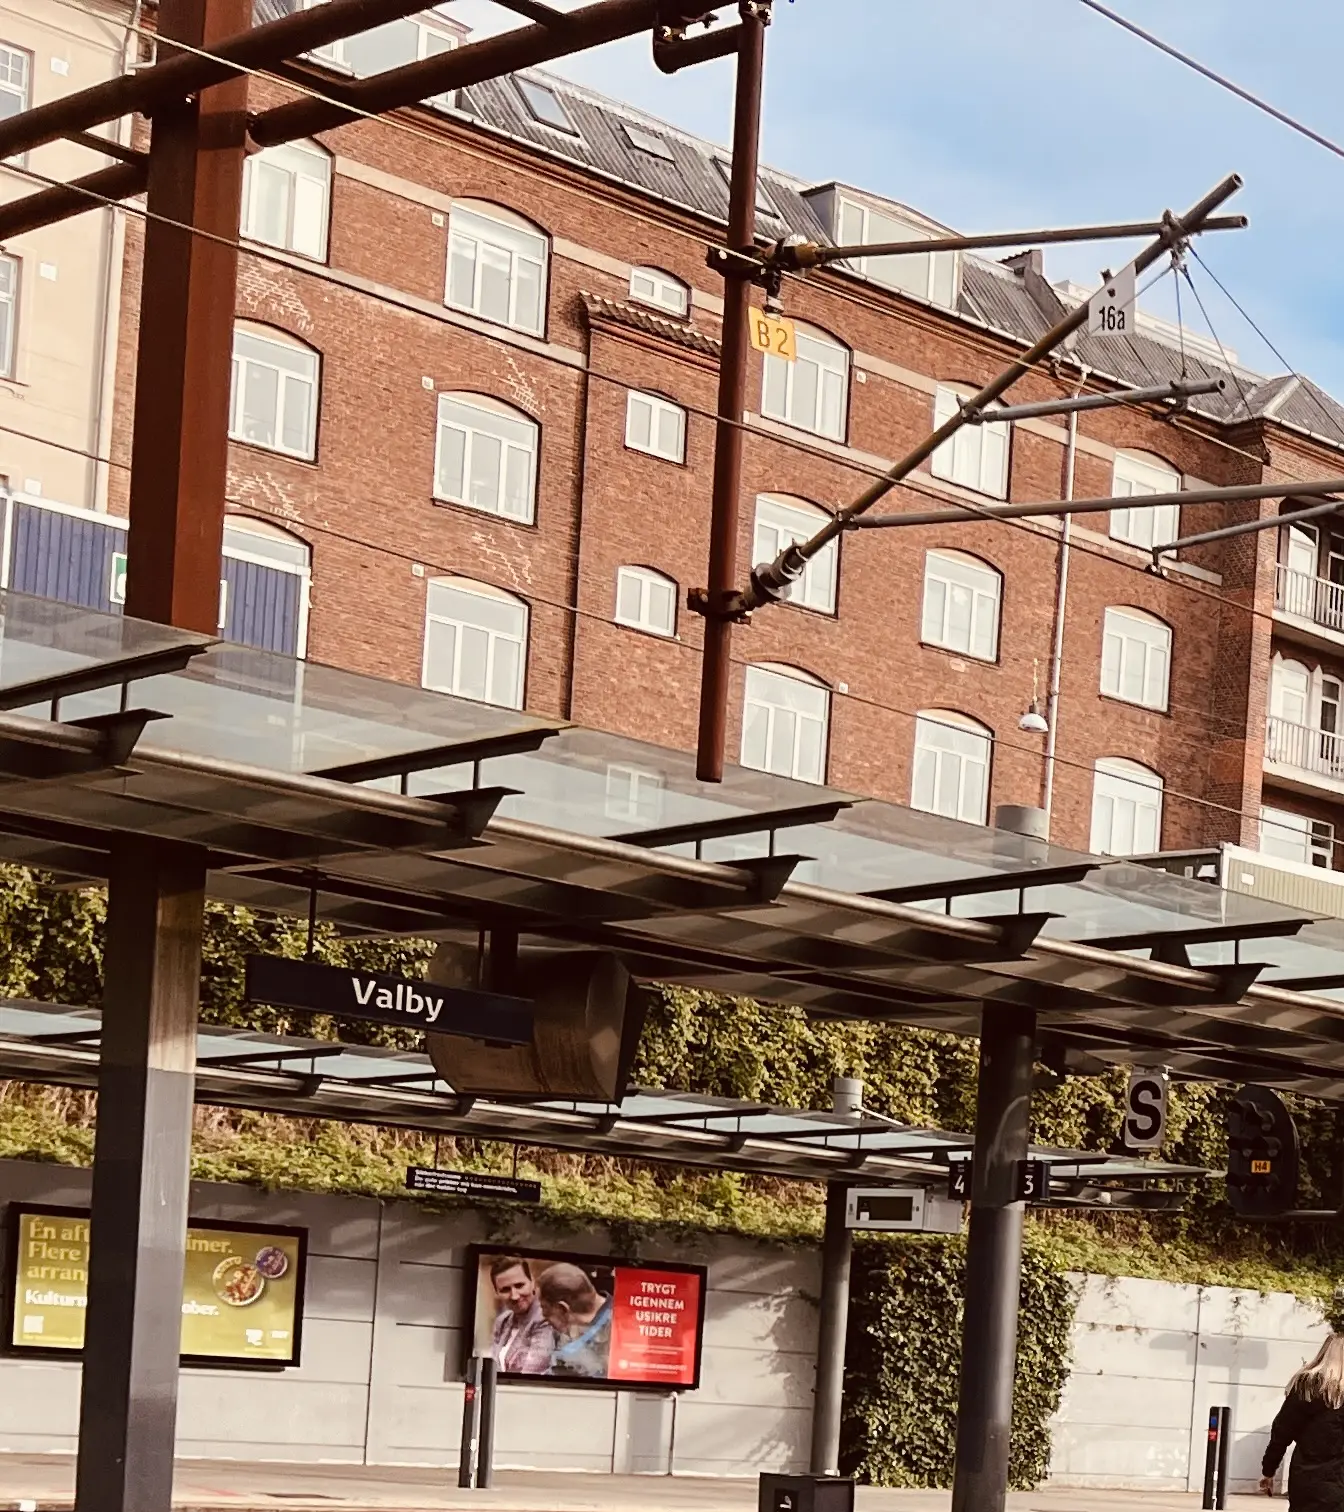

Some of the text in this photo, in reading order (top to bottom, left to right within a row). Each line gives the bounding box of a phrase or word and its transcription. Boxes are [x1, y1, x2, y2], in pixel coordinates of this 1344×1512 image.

[1098, 305, 1126, 331] 16a
[351, 976, 444, 1023] Valby
[1127, 1080, 1162, 1141] S
[954, 1174, 965, 1194] 4
[1023, 1174, 1034, 1195] 3
[28, 1240, 82, 1262] Flere
[640, 1281, 677, 1295] TRYGT
[629, 1295, 685, 1311] IGENNEM
[635, 1310, 677, 1324] USIKRE
[638, 1324, 673, 1338] TIDER
